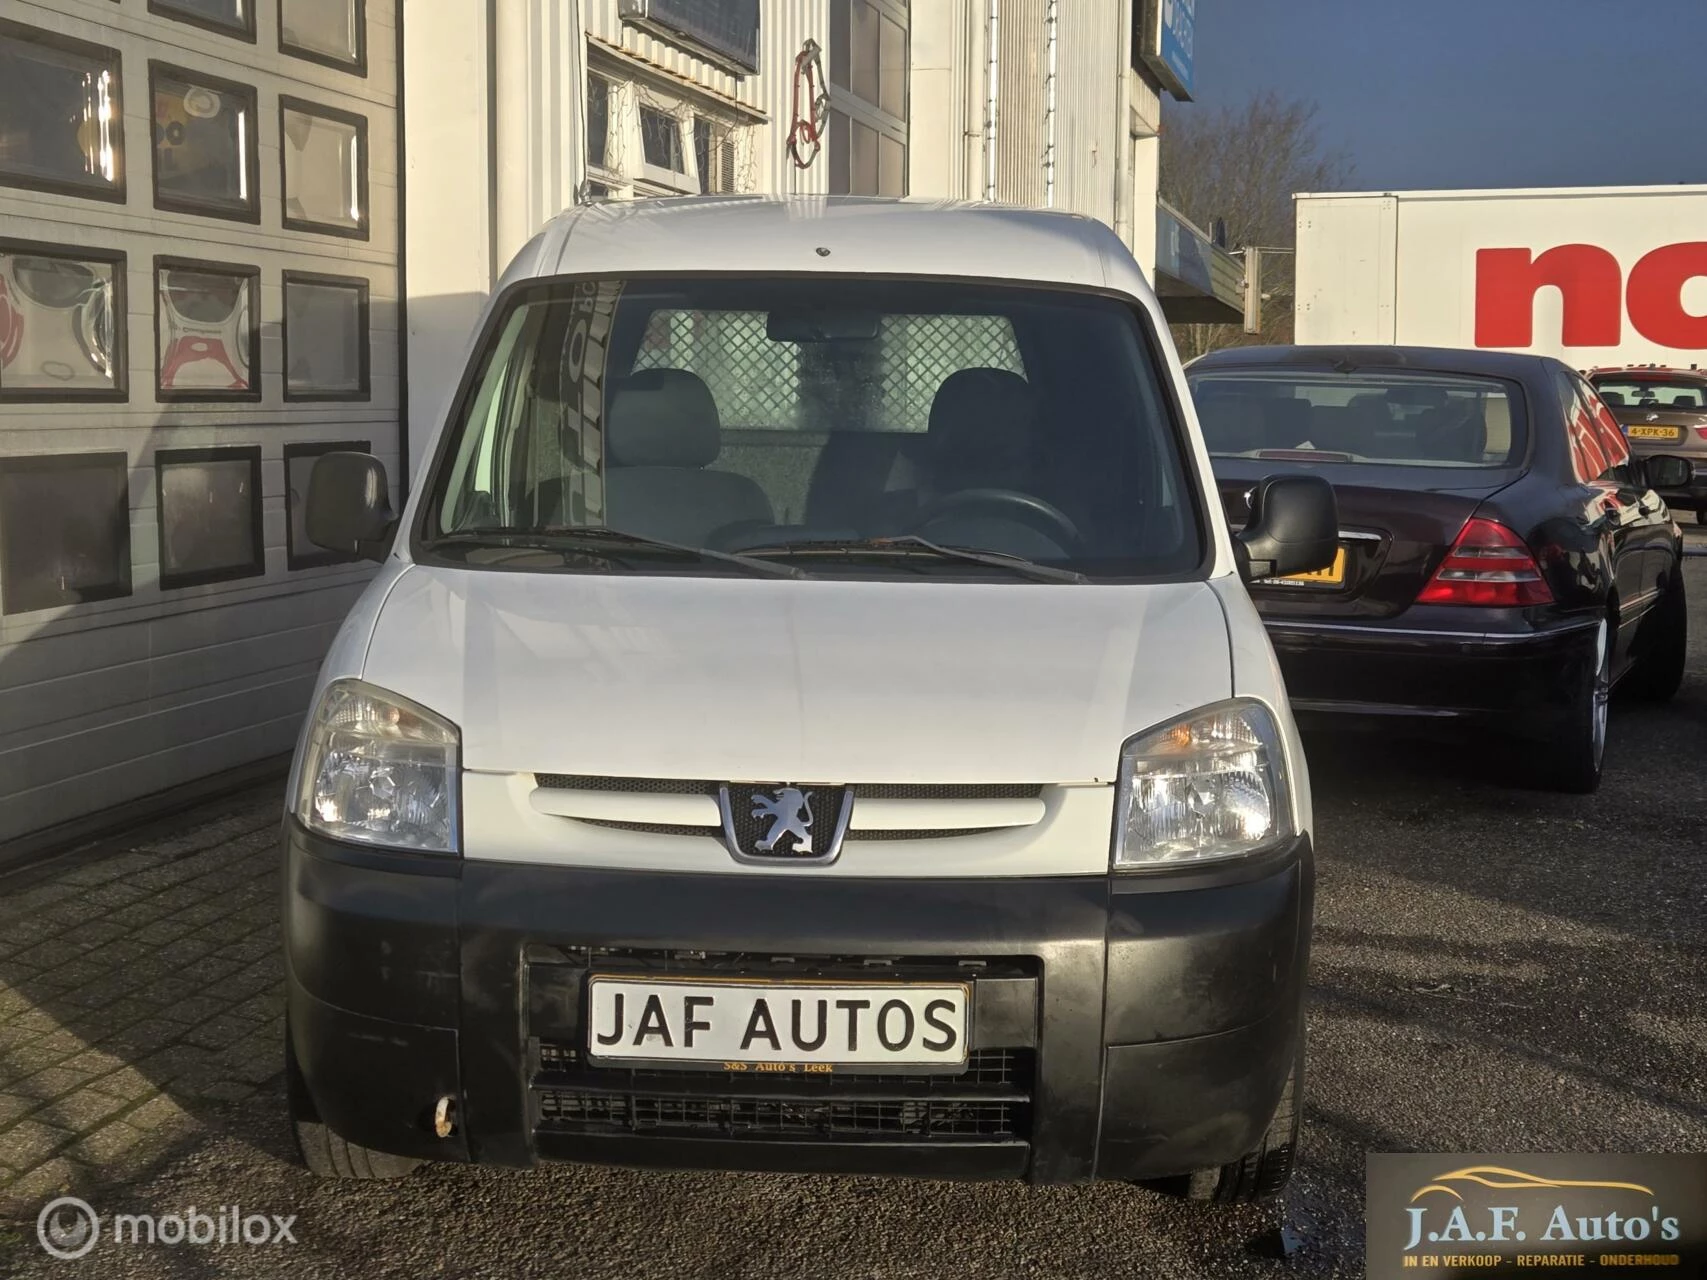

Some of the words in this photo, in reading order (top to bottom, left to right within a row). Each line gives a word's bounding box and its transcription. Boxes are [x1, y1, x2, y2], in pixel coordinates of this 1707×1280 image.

[597, 993, 714, 1048] JAF
[740, 998, 957, 1053] AUTOS
[804, 1063, 833, 1073] Leek
